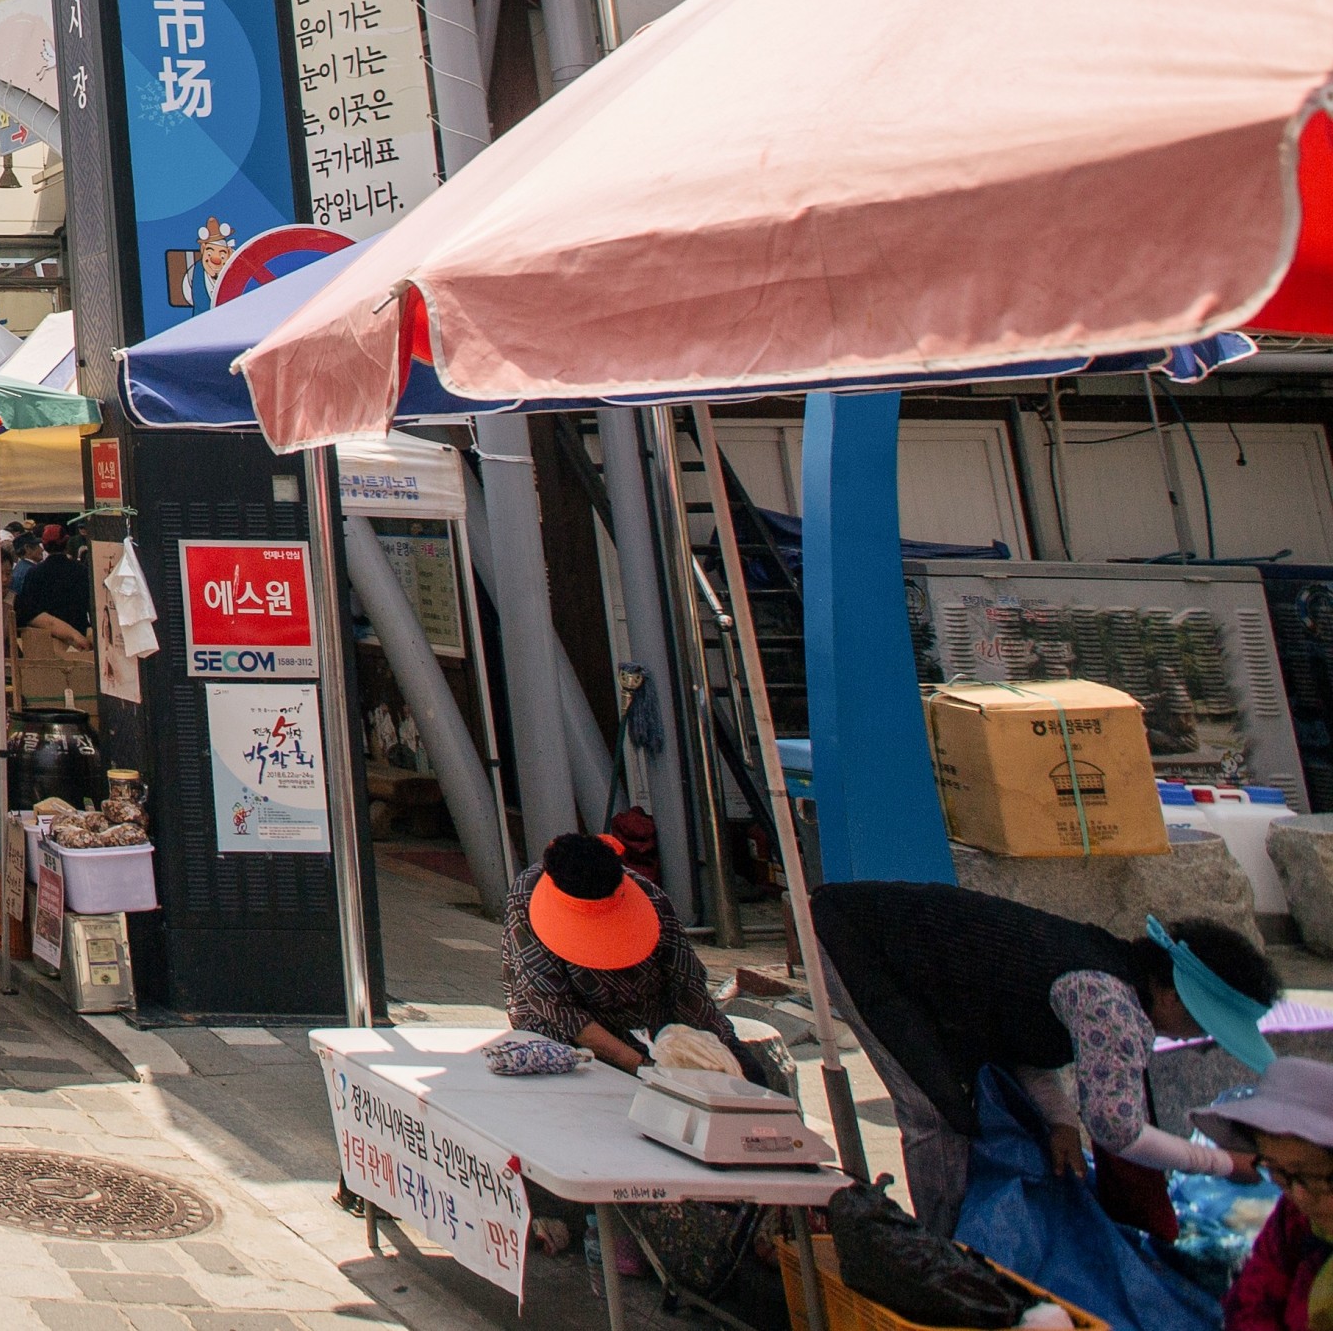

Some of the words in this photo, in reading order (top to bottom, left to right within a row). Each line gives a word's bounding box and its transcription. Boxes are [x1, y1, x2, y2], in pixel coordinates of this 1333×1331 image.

[338, 0, 382, 33] 가는
[299, 54, 338, 93] 눈이
[343, 45, 387, 78] 가는
[328, 88, 393, 128] 이곳은
[312, 138, 400, 179] 국가대표
[313, 181, 404, 226] 장입니다.
[97, 461, 116, 480] 에스원
[262, 549, 285, 560] 언제나
[286, 550, 301, 560] 안심
[204, 579, 293, 617] 에스원
[193, 650, 276, 673] SECOM
[278, 657, 313, 667] 1588-3112
[351, 1083, 428, 1161] 정선시니어클럽
